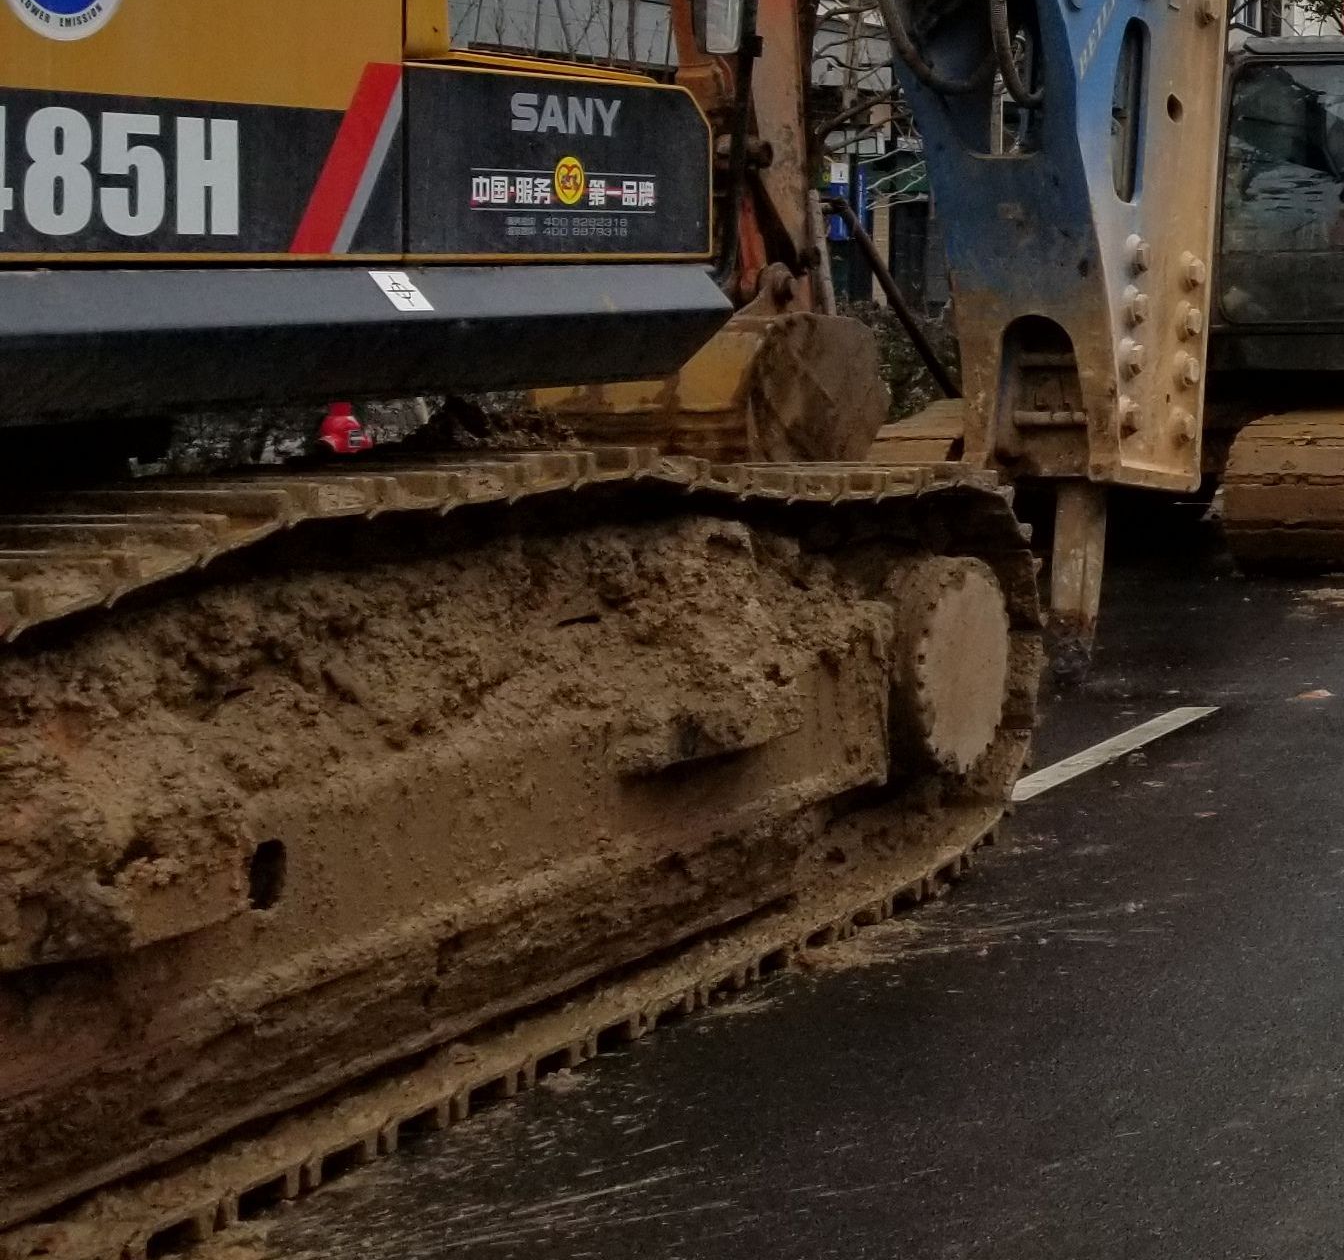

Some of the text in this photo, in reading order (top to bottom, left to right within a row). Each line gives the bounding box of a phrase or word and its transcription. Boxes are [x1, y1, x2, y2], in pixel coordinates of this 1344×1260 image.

[59, 2, 104, 28] EMISSION
[511, 92, 622, 137] SANY
[0, 106, 239, 237] 85H
[588, 178, 655, 207] 第一品牌
